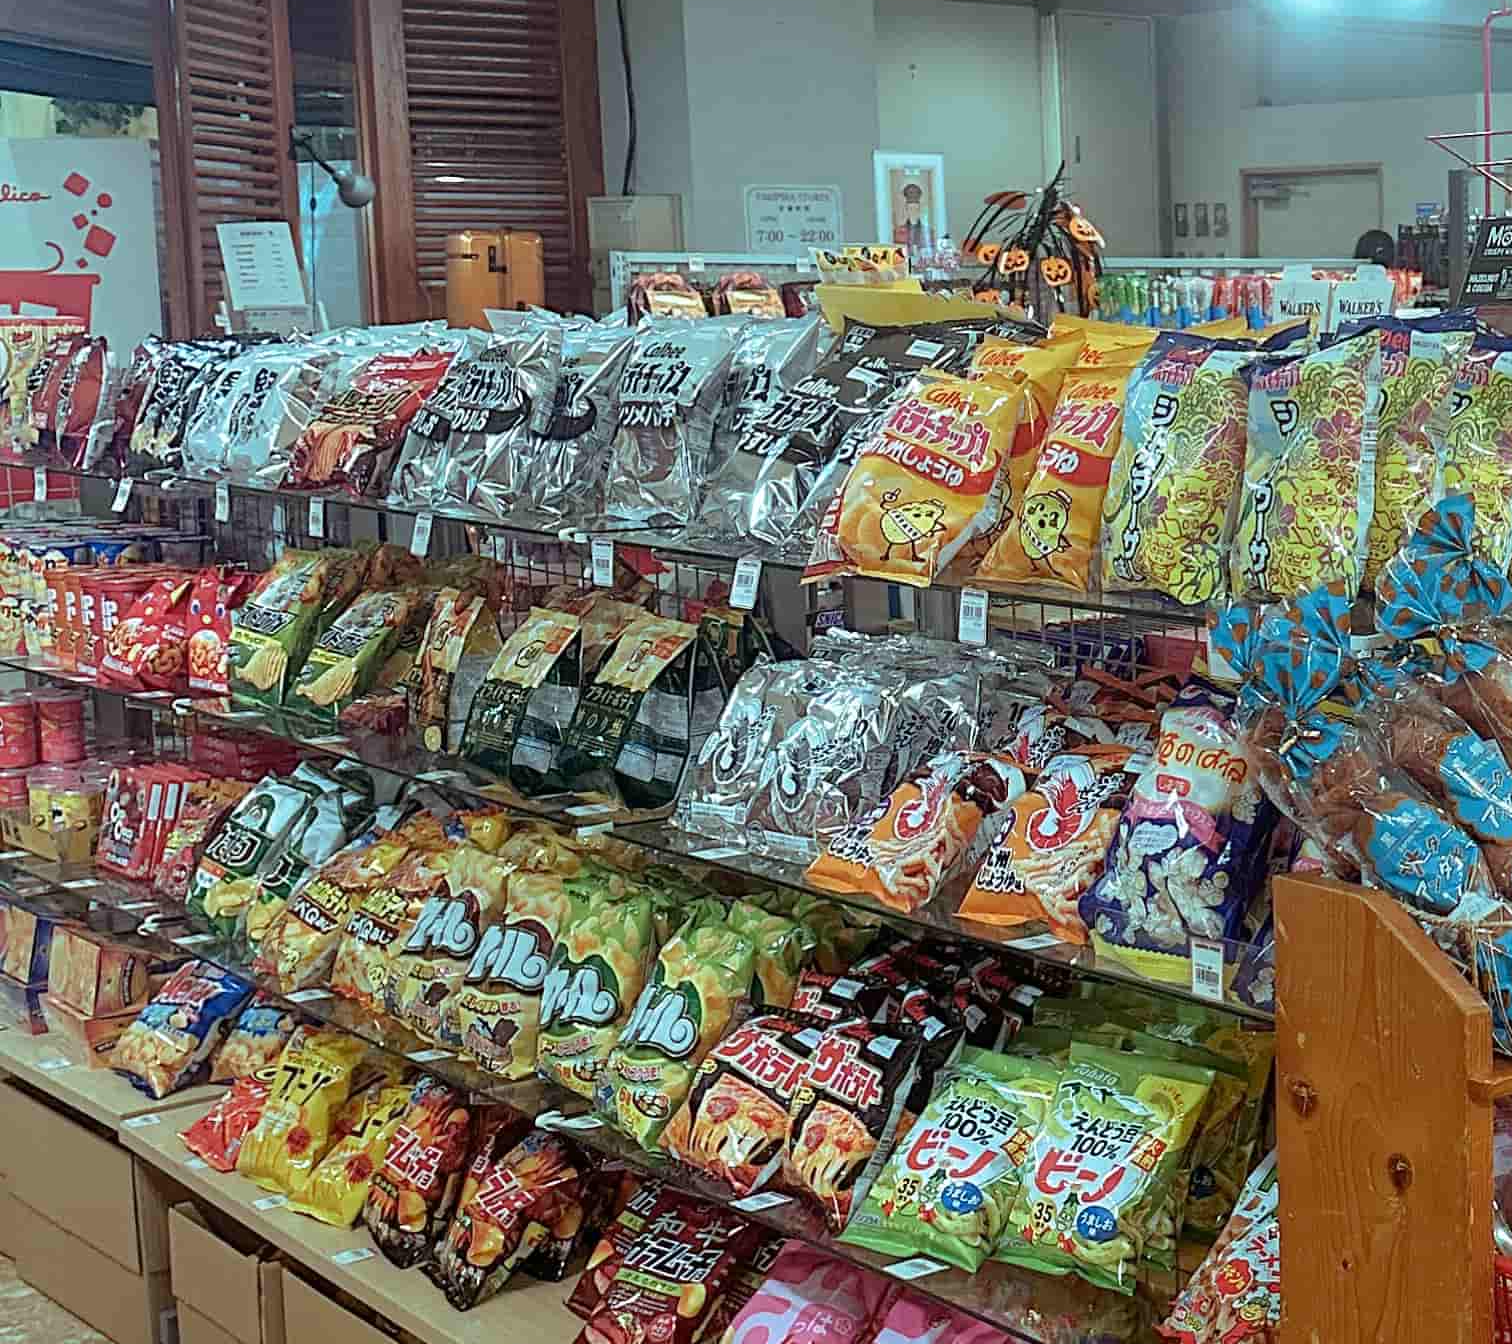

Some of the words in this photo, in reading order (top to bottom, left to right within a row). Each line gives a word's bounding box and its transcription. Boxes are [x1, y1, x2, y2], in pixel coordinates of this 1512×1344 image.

[941, 1112, 996, 1146] 100%
[1068, 1110, 1142, 1144] えんどう豆
[906, 1129, 998, 1178] ビーノ
[1070, 1135, 1122, 1159] 100%
[1034, 1149, 1126, 1204] ビーノ
[1033, 1202, 1054, 1221] 35
